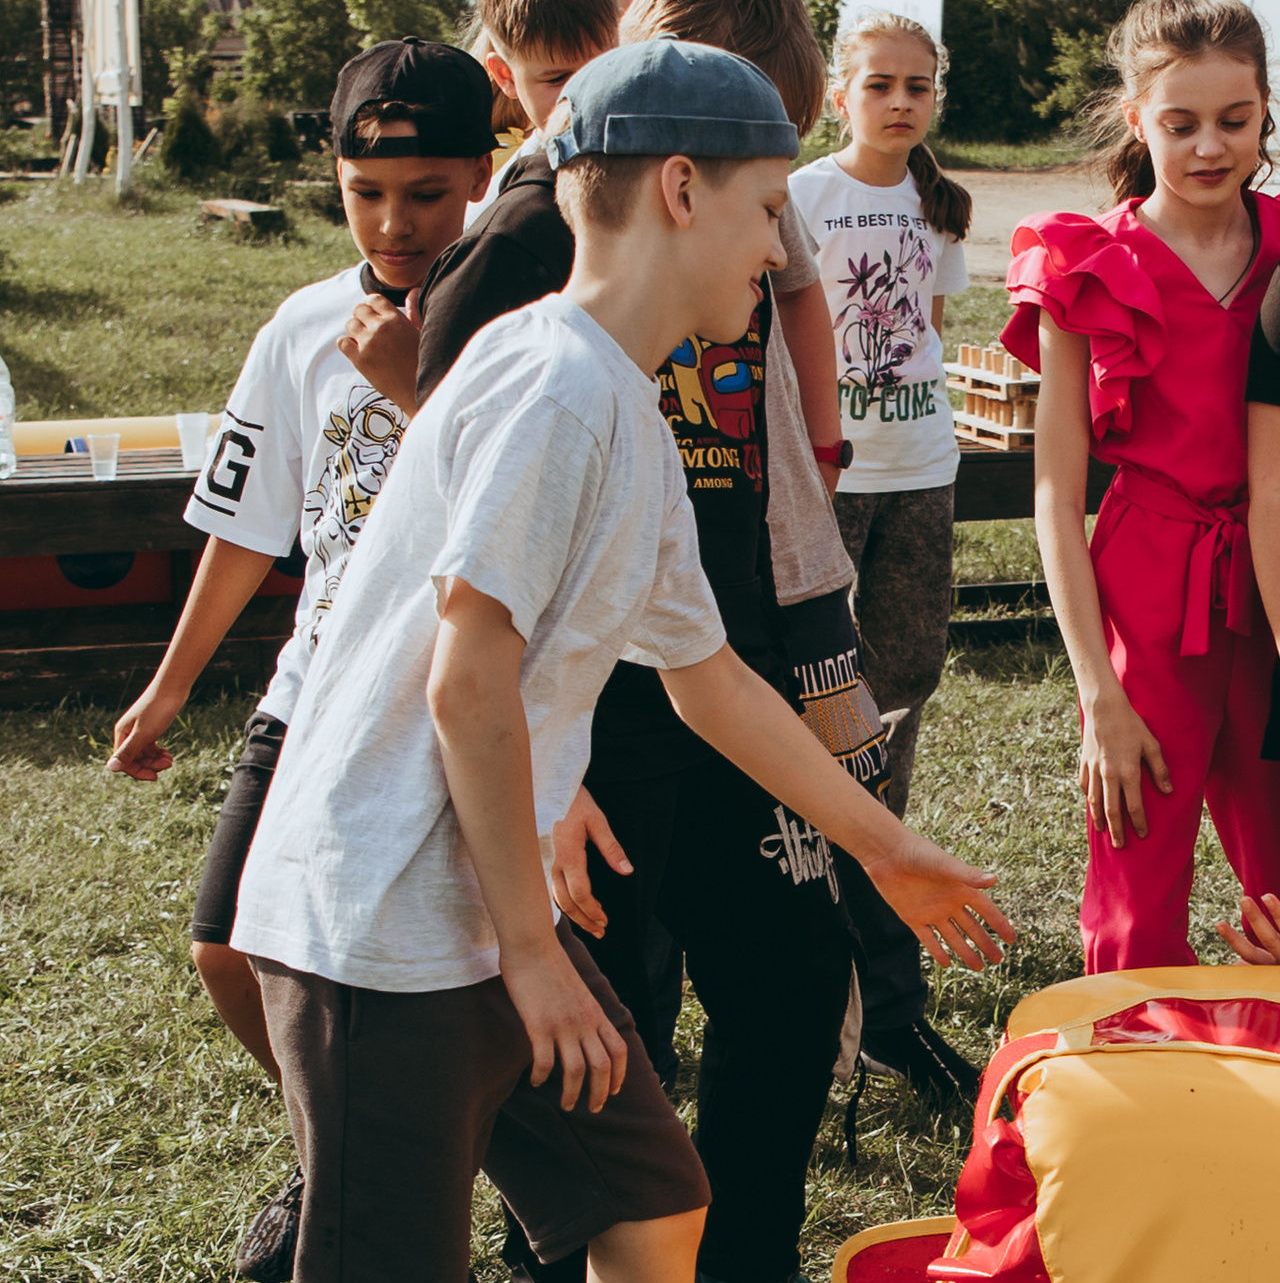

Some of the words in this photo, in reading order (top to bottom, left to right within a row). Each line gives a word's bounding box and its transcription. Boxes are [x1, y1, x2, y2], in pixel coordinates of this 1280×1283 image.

[824, 216, 853, 231] THE
[858, 214, 893, 228] BEST
[897, 214, 909, 228] IS
[880, 379, 938, 423] COME
[680, 446, 741, 469] MONG
[693, 477, 733, 489] AMONG
